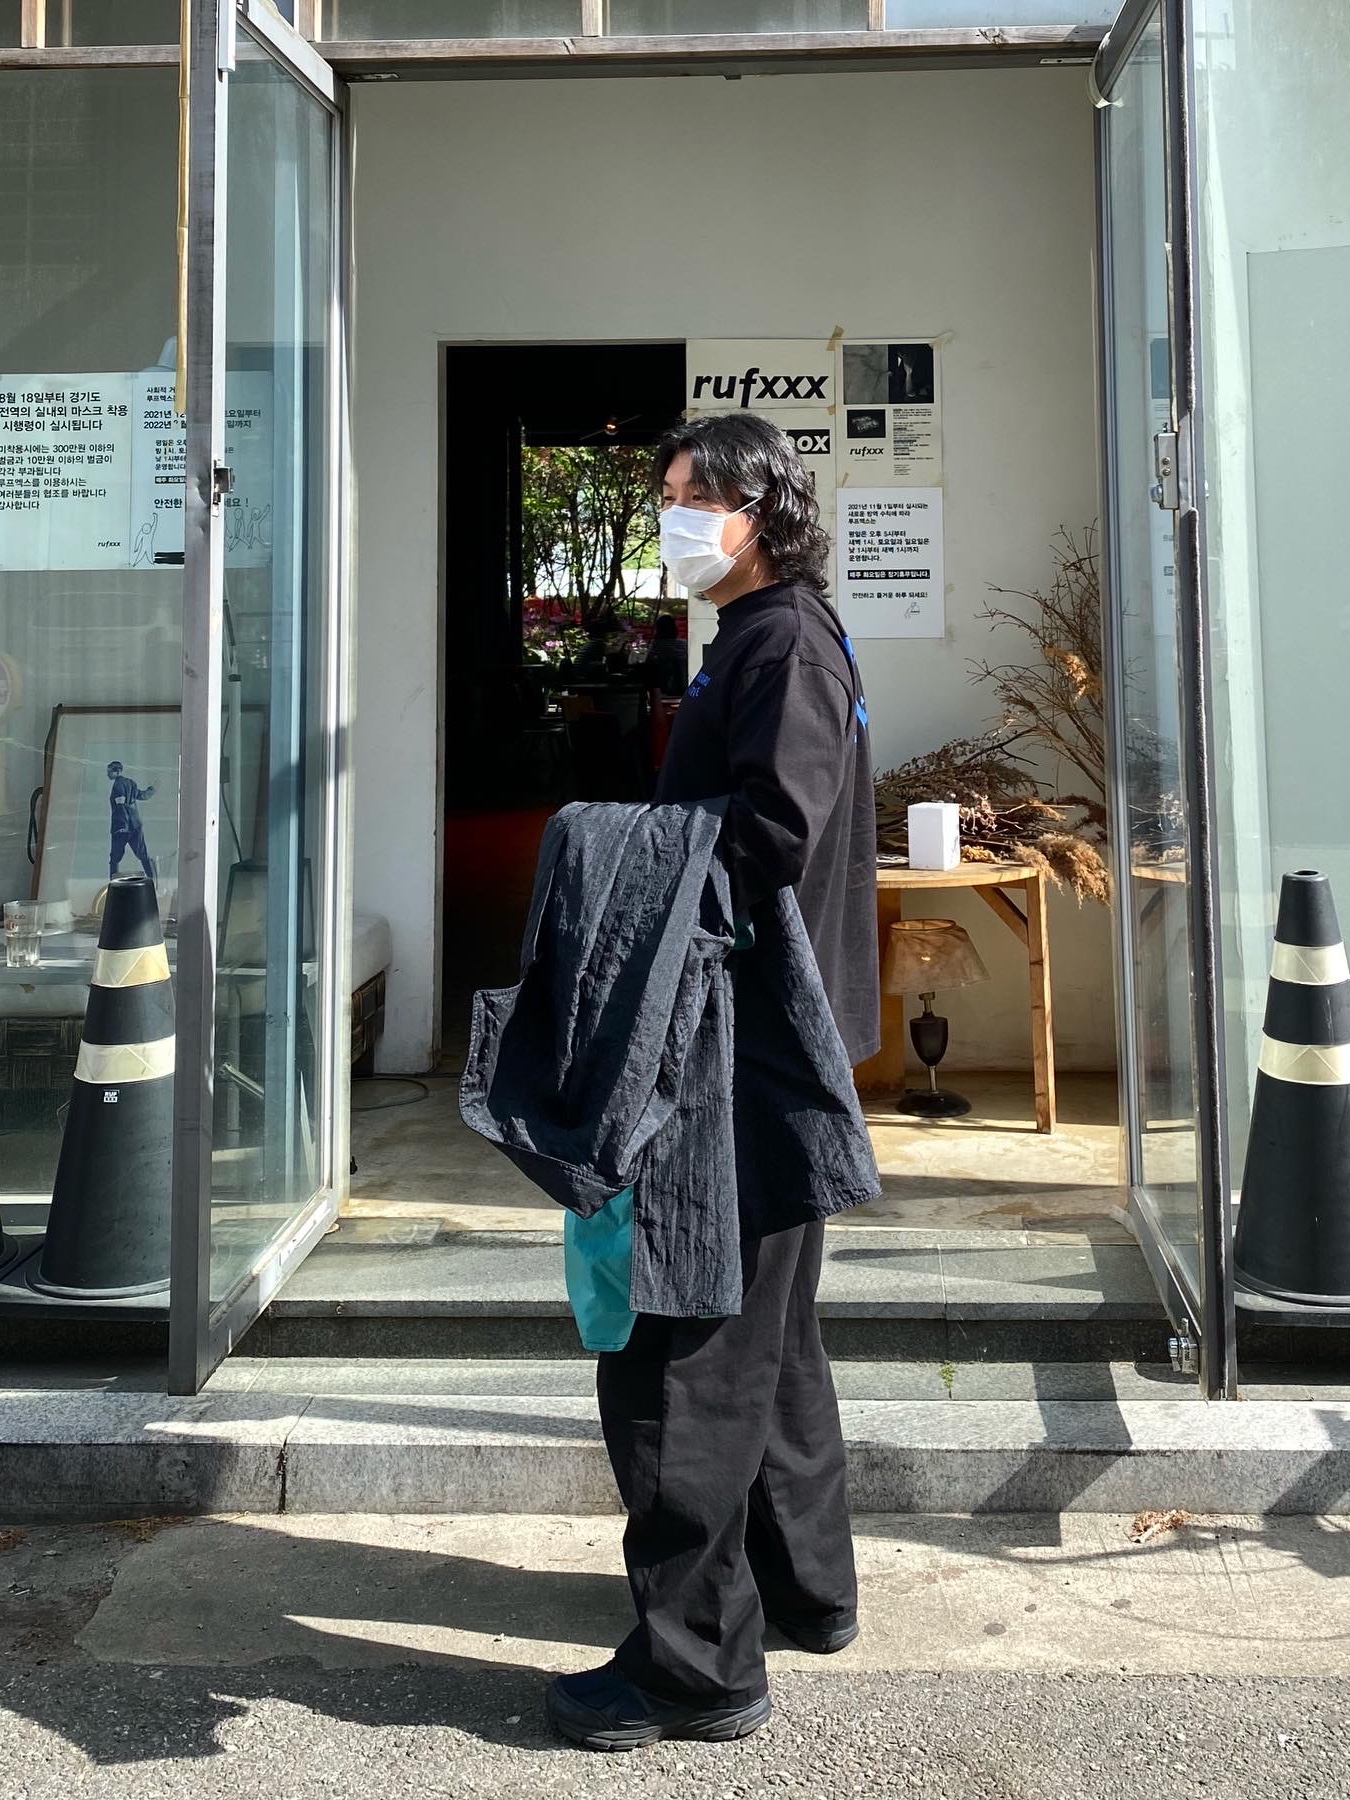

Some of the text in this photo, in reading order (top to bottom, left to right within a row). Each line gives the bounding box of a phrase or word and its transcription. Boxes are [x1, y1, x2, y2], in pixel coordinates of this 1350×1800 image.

[693, 367, 829, 408] rufxxx
[20, 391, 65, 403] 18일부터
[70, 391, 101, 403] 경기도
[0, 404, 128, 417] 전역의 실내외 마스크 착용
[143, 410, 172, 418] 2021년
[3, 420, 103, 431] 시행령이 실시됩니다
[143, 420, 172, 429] 2022년
[53, 444, 86, 454] 300만원
[90, 443, 115, 453] 이하의
[849, 446, 884, 457] rufxxx
[27, 456, 55, 465] 10만원
[58, 456, 84, 465] 이하의
[87, 455, 112, 464] 벌금이
[18, 467, 61, 477] 부과됩니다
[44, 478, 87, 488] 이용하시는
[44, 489, 69, 499] 협조를
[73, 489, 107, 498] 바랍니다
[154, 498, 183, 508] 안전한
[98, 541, 121, 549] rufxxx
